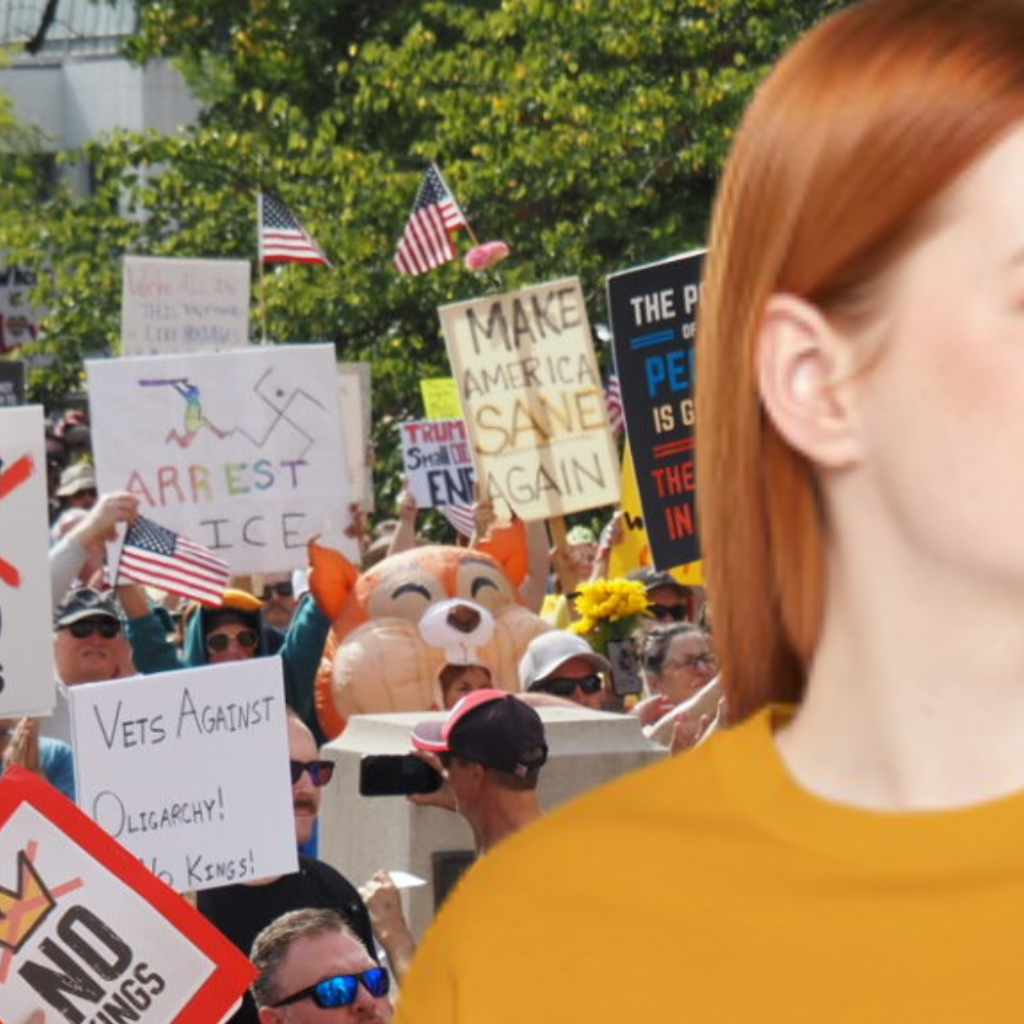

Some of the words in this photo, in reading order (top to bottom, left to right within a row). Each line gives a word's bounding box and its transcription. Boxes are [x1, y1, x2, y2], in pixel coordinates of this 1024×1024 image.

[465, 285, 583, 355] MAKE
[630, 288, 676, 326] THE
[463, 353, 600, 399] AMERICA
[474, 386, 609, 459] SANE
[653, 403, 675, 433] IS
[124, 458, 308, 507] ARREST
[486, 452, 607, 508] AGAIN
[200, 512, 308, 551] ICE
[665, 503, 694, 540] IN
